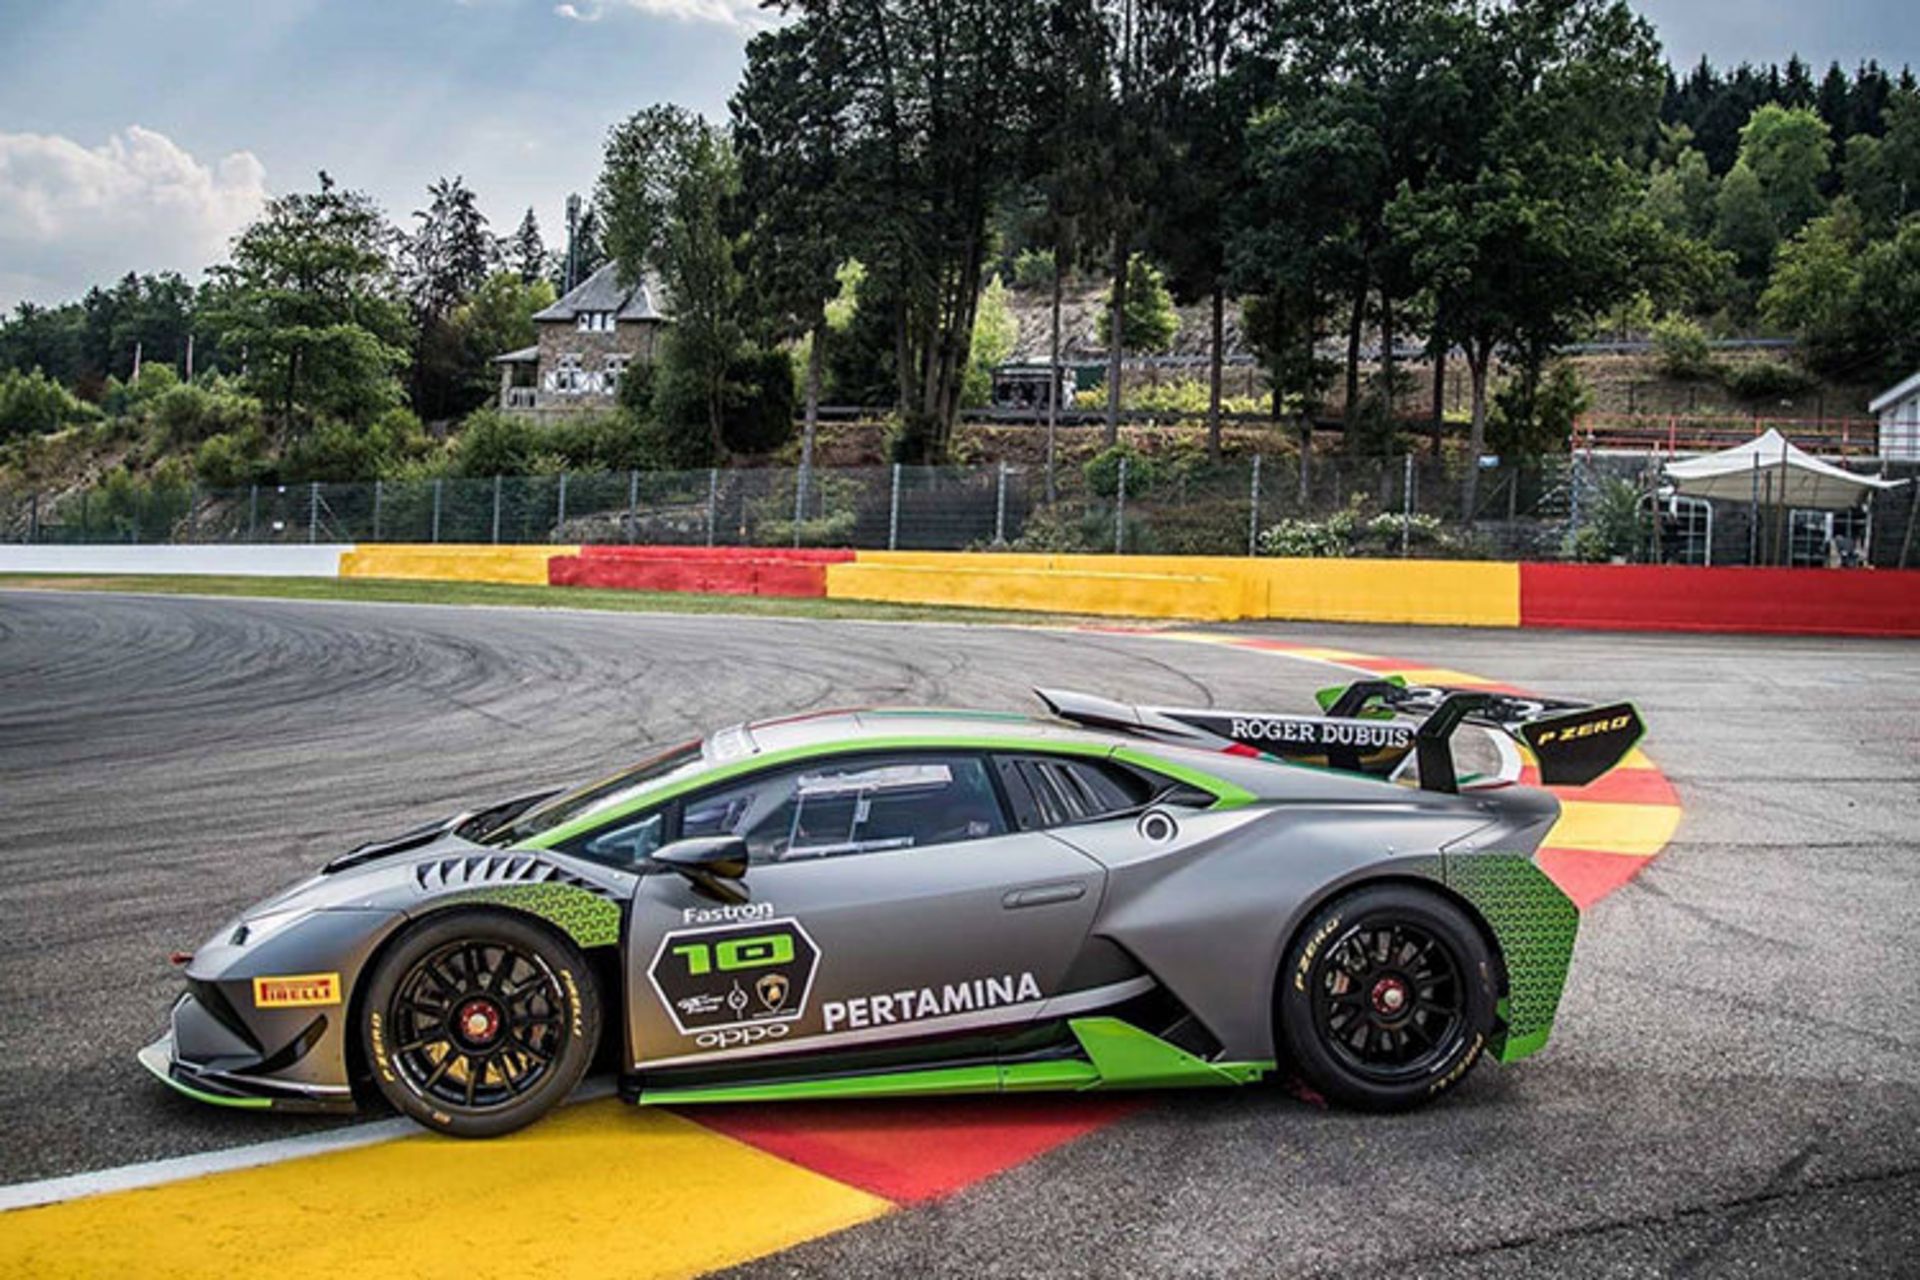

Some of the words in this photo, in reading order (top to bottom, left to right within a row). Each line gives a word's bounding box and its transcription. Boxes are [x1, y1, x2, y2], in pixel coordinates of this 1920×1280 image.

[1231, 719, 1315, 742] ROGER
[1322, 723, 1409, 748] DUBUIS
[1537, 731, 1556, 746] P
[1559, 714, 1632, 741] ZERO
[683, 902, 774, 923] Fastron
[672, 933, 795, 975] 10
[261, 979, 330, 1002] PIRELLI
[823, 972, 1041, 1031] PERTAMINA
[696, 1023, 790, 1048] oppo
